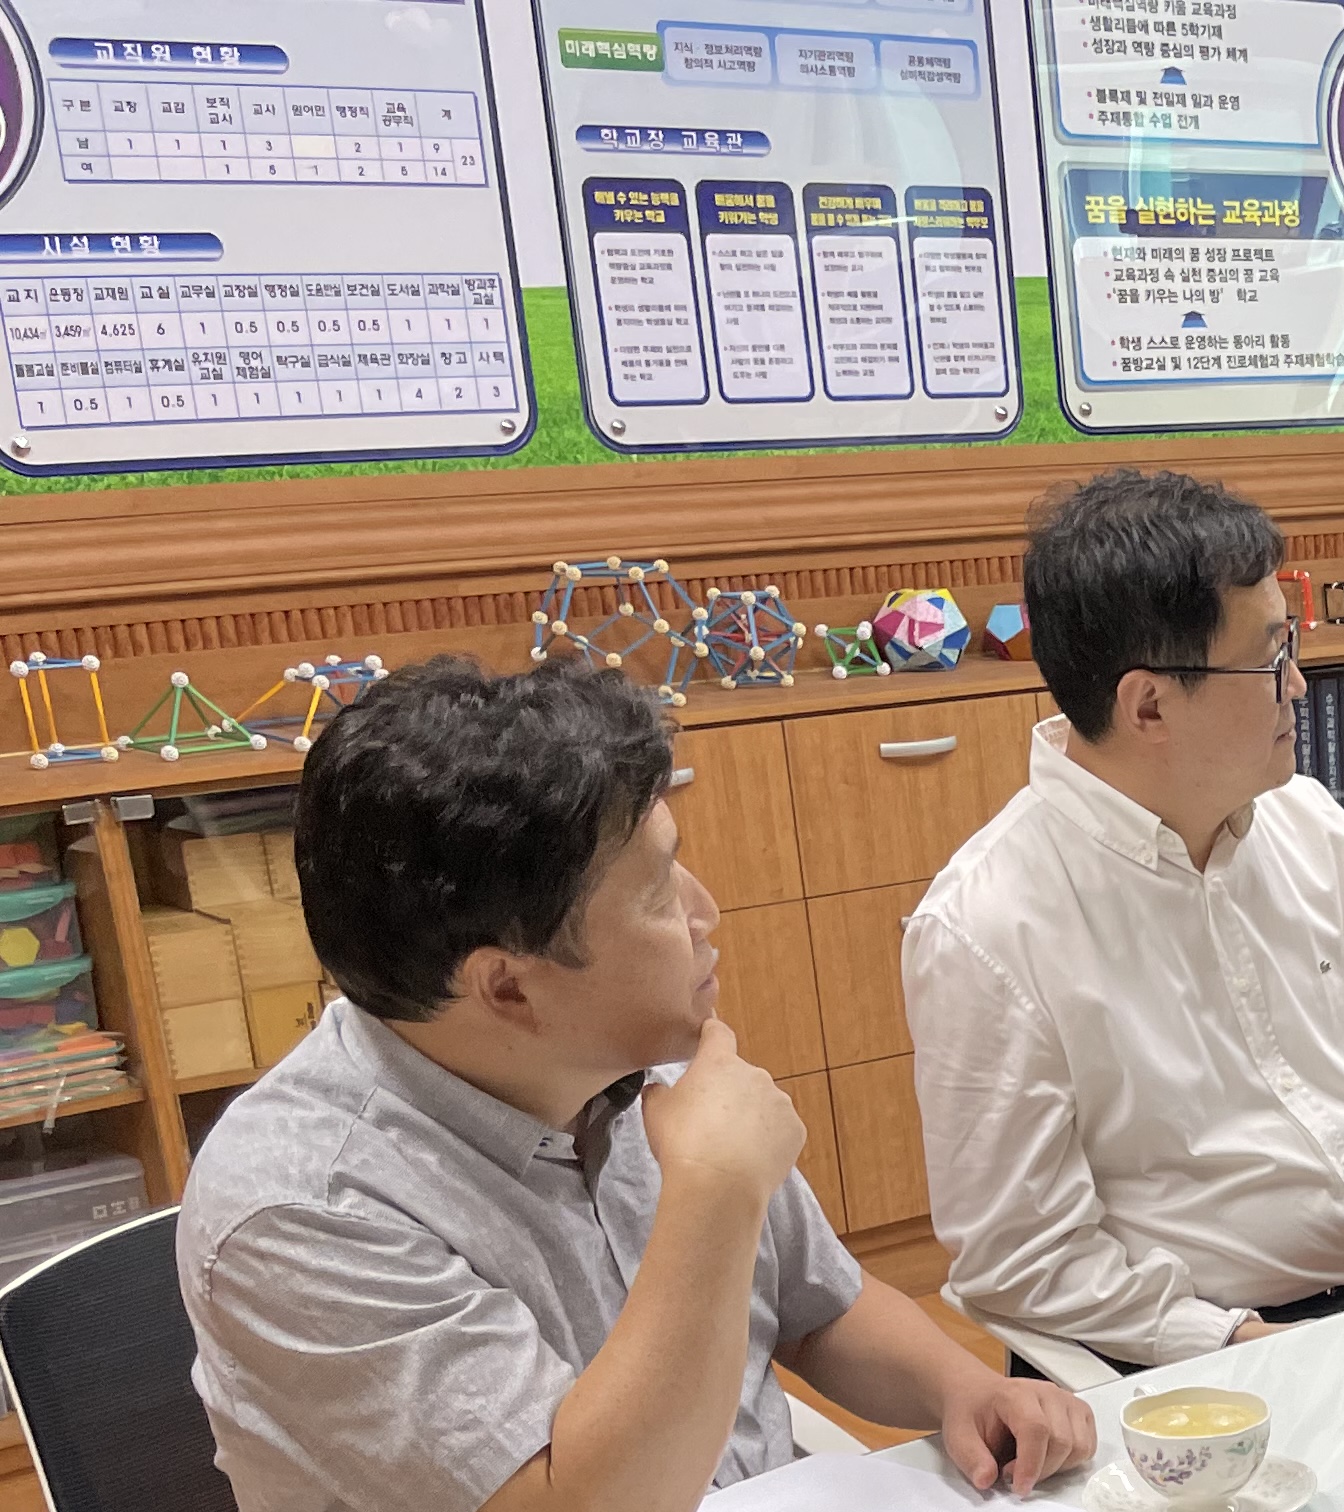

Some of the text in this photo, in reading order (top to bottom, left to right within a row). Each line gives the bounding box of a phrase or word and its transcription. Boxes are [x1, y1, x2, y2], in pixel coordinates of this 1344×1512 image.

[1192, 3, 1237, 20] 교육과정
[1154, 21, 1176, 37] 따른
[94, 42, 241, 66] 교직원 현황
[564, 39, 658, 61] 미래핵심역량
[673, 42, 694, 55] 지식
[1091, 38, 1127, 55] 성장과
[1132, 41, 1155, 57] 역량
[1160, 42, 1195, 60] 중심의
[1199, 45, 1221, 62] 평가
[113, 100, 137, 114] 교장
[206, 97, 231, 110] 보직
[1136, 90, 1147, 106] 및
[1191, 93, 1213, 110] 일과
[1218, 95, 1240, 111] 운영
[253, 103, 276, 116] 교사
[292, 104, 326, 117] 원어민
[209, 112, 233, 126] 교사
[1098, 110, 1200, 130] 주제통합 수업 전개
[266, 141, 272, 151] 3
[600, 128, 744, 152] 학교장 교육관
[354, 142, 361, 153] 2
[460, 155, 475, 166] 23
[81, 162, 93, 174] 여
[357, 166, 365, 176] 2
[433, 167, 447, 177] 14
[1085, 194, 1300, 229] 꿈을 실현하는 교육과정
[42, 235, 161, 256] 시설 현황
[1151, 247, 1275, 263] 미래의 꿈 성장 프로젝트
[1113, 268, 1280, 283] 교육과정 속 실천 중심의 꿈 교육
[222, 284, 258, 298] 교장실
[264, 284, 300, 298] 행정실
[347, 283, 381, 297] 보건실
[387, 283, 421, 297] 도서실
[428, 283, 461, 297] 과학실
[465, 278, 497, 290] 방과후
[50, 287, 84, 302] 운동장
[93, 287, 129, 301] 교재원
[180, 284, 215, 299] 교무실
[1145, 288, 1179, 304] 키우는
[1183, 289, 1204, 304] 나의
[1237, 288, 1258, 303] 학교
[473, 293, 494, 305] 교실
[156, 323, 165, 335] 6
[234, 321, 258, 333] 0.5
[276, 320, 299, 333] 0.5
[318, 320, 341, 332] 0.5
[358, 319, 380, 332] 0.5
[1119, 334, 1290, 351] 학생 스스로 운영하는 동아리 활동
[191, 351, 227, 366] 유치원
[239, 351, 263, 365] 영어
[276, 355, 311, 368] 탁구실
[318, 354, 352, 368] 급식실
[357, 353, 391, 367] 체육관
[398, 353, 431, 366] 화장실
[1171, 356, 1182, 371] 및
[1187, 355, 1223, 370] 12단계
[104, 361, 143, 375] 컴퓨터실
[199, 367, 223, 380] 교실
[236, 366, 271, 379] 체험실
[415, 388, 423, 399] 4
[455, 387, 463, 398] 2
[493, 386, 500, 397] 3
[73, 398, 98, 411] 0.5
[161, 395, 184, 408] 0.5
